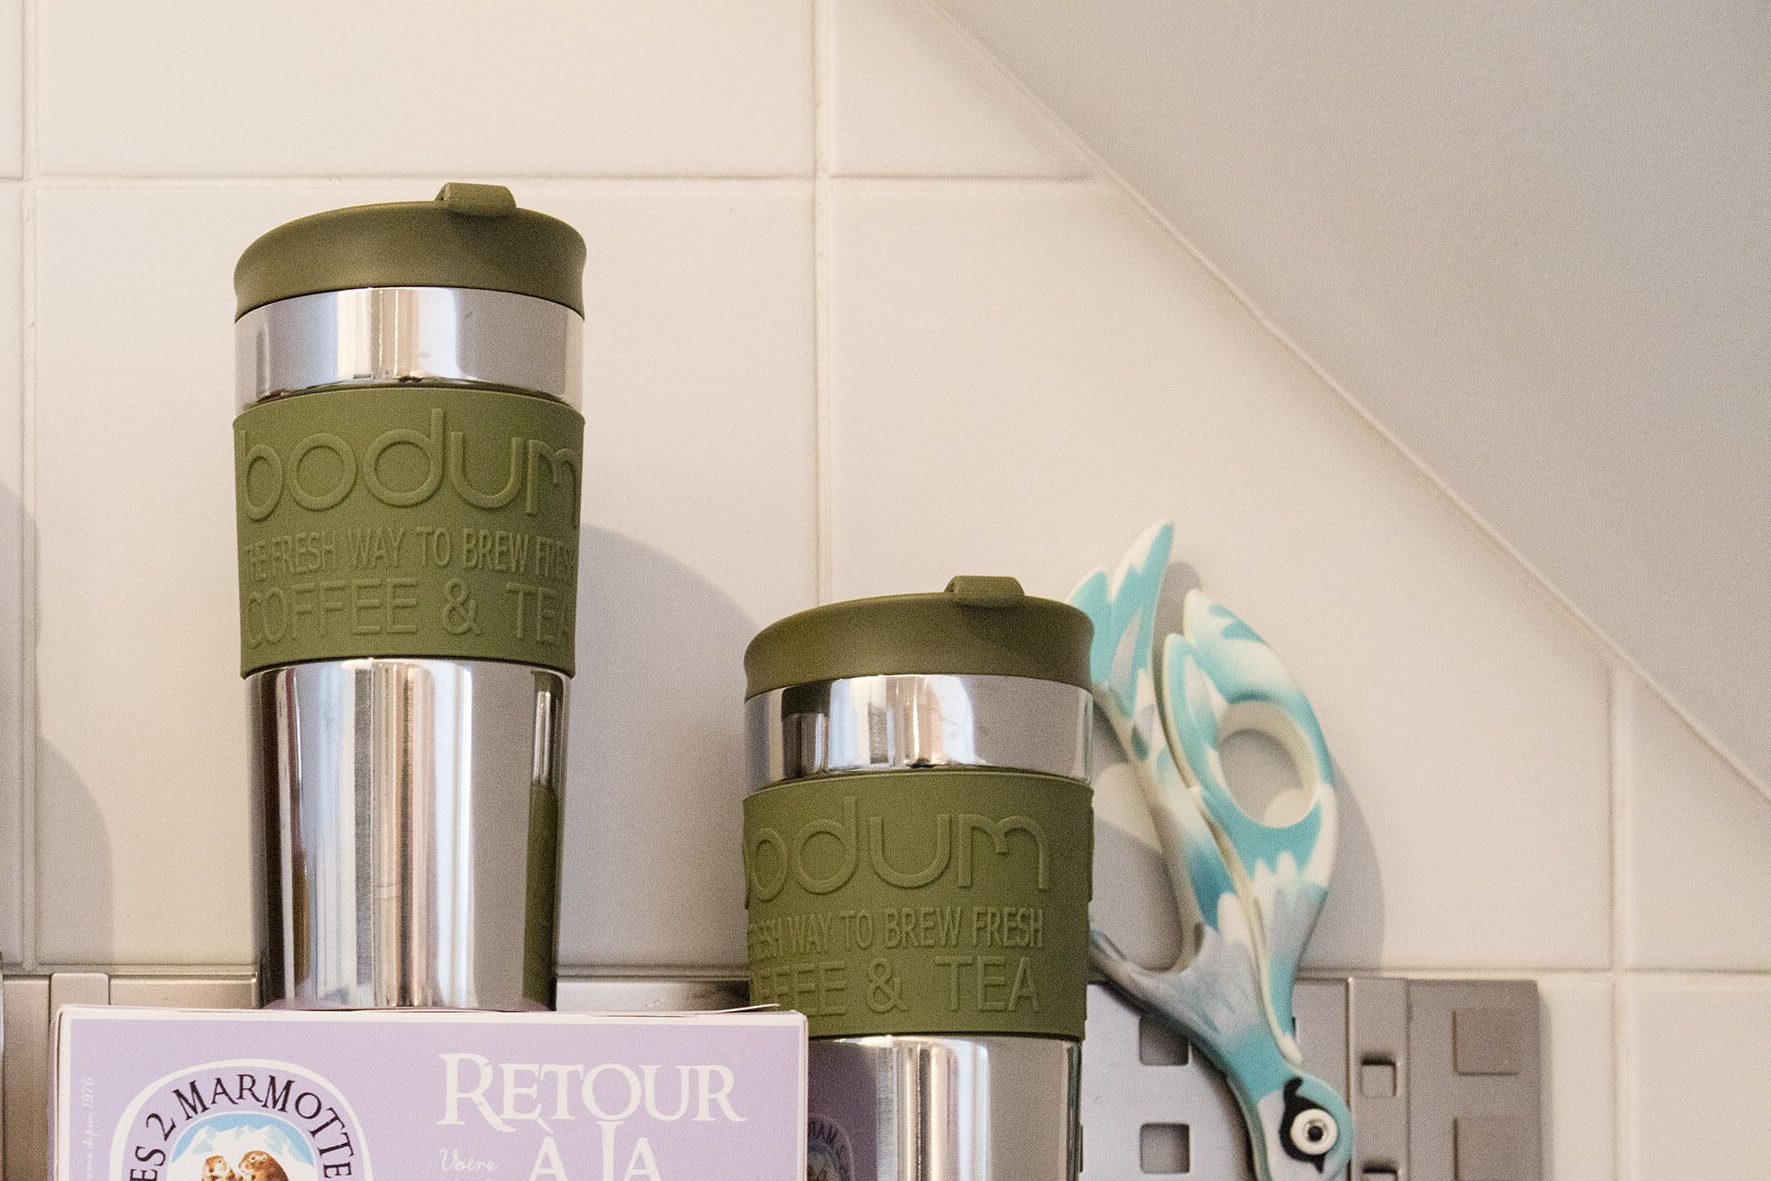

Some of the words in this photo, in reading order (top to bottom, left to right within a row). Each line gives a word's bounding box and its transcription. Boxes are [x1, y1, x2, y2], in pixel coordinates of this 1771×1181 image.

[239, 407, 580, 530] bodum
[270, 528, 338, 576] FRESH
[347, 526, 405, 569] WAY
[415, 526, 453, 569] TO
[462, 526, 530, 575] BREW
[244, 576, 420, 650] COFFEE
[441, 577, 482, 637] &
[748, 796, 1050, 902] odum
[786, 911, 833, 955] WAY
[839, 909, 875, 951] TO
[883, 906, 962, 950] BREW
[971, 906, 1046, 950] FRESH
[865, 956, 909, 1014] &
[933, 955, 1042, 1014] TEA
[436, 1052, 748, 1134] RETOUR
[145, 1111, 177, 1142] 2
